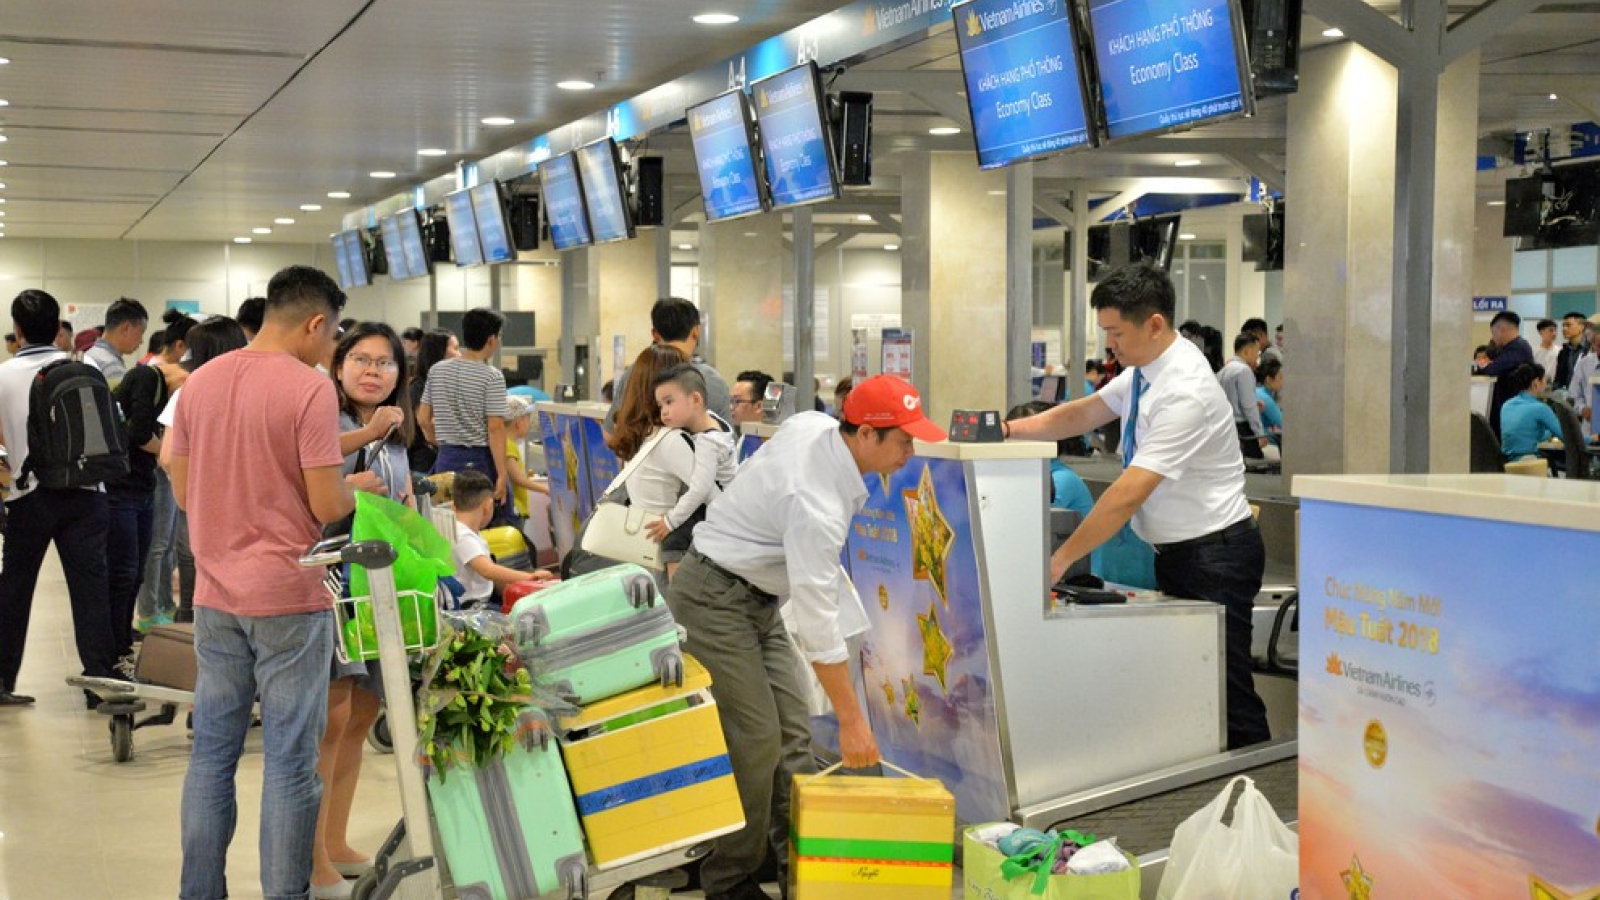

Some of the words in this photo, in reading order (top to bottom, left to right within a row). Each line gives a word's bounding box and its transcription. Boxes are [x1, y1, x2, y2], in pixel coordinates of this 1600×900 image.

[1109, 33, 1135, 55] KHÁCH
[1180, 9, 1213, 34] THÔNG
[1036, 54, 1062, 76] THÔNG
[1130, 60, 1171, 85] Economy
[1173, 51, 1198, 73] Class
[996, 97, 1030, 118] Economy
[1030, 91, 1053, 111] Class
[1491, 300, 1504, 310] RA
[1325, 576, 1349, 599] Chúc
[1324, 606, 1356, 640] Mậu
[1359, 612, 1394, 645] Tuất
[1398, 620, 1439, 655] 2018
